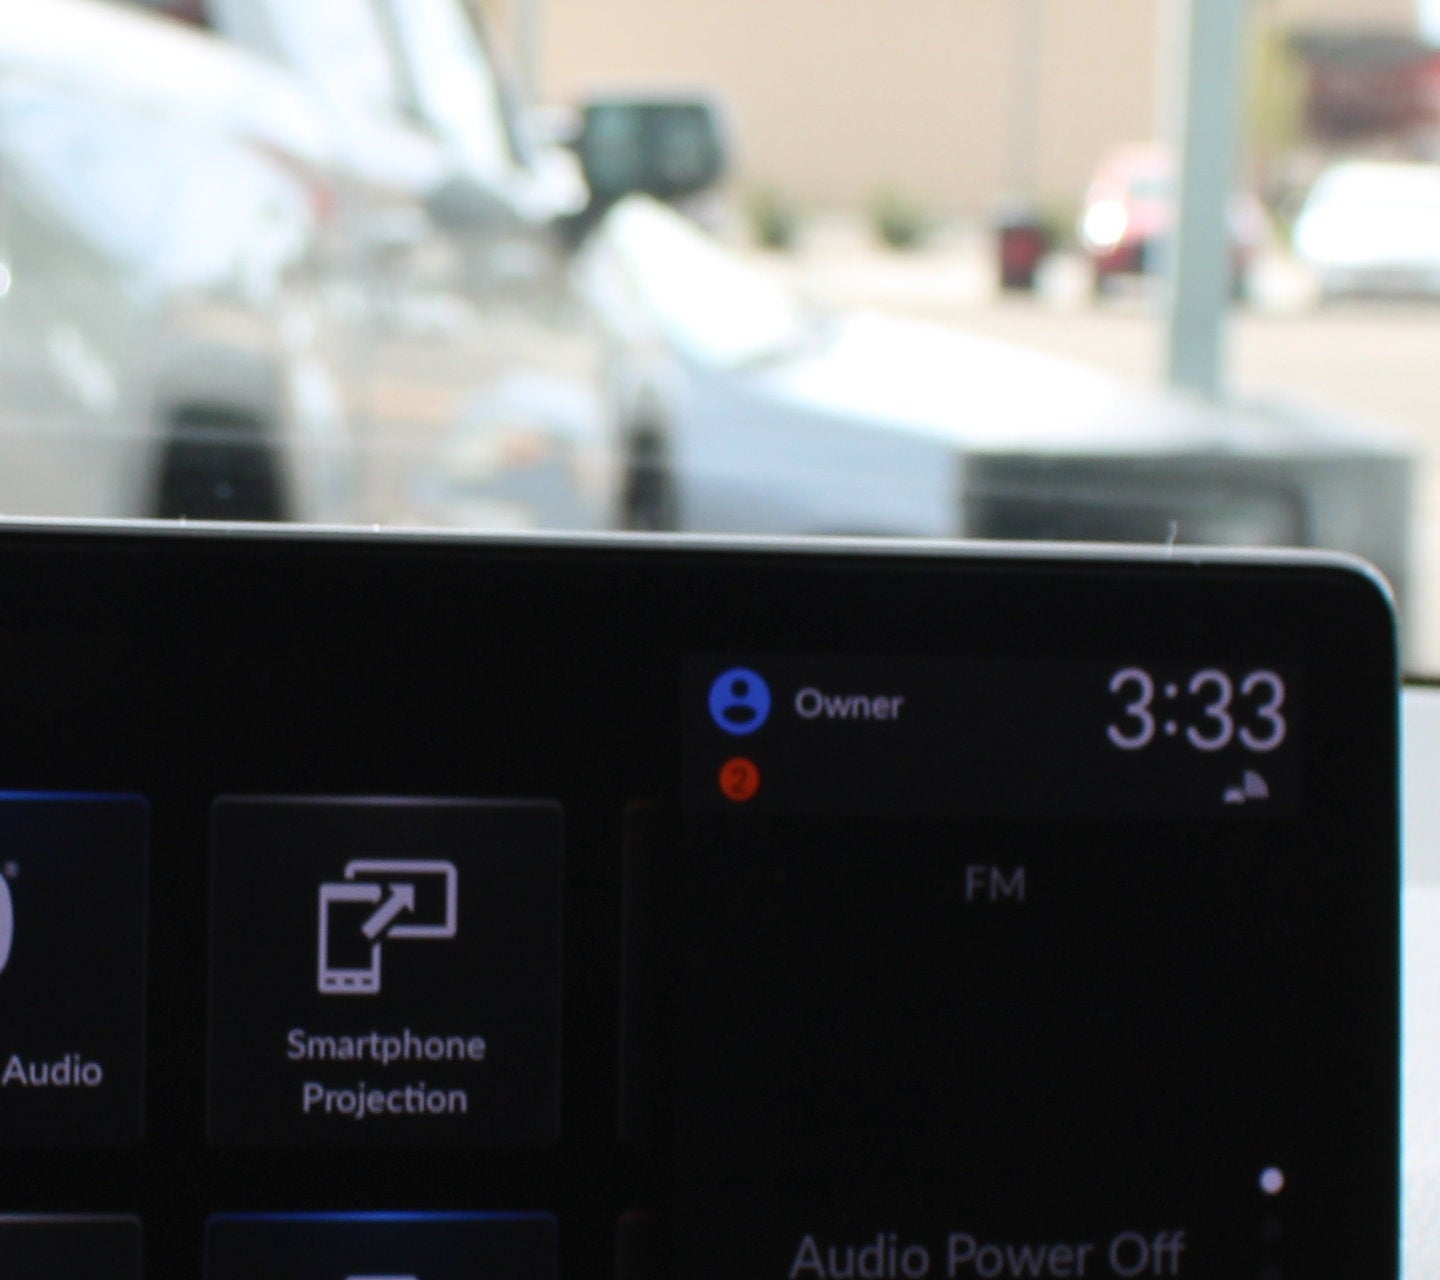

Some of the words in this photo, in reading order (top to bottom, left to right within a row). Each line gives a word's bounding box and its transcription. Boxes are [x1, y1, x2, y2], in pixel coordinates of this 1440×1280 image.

[793, 686, 905, 721] Owner
[1105, 666, 1287, 753] 3:33
[964, 863, 1027, 902] FM
[286, 1027, 487, 1067] Smartphone
[0, 1052, 104, 1087] Audio
[301, 1080, 469, 1120] Projection
[787, 1231, 931, 1280] Audio
[946, 1231, 1095, 1279] Power
[1107, 1228, 1186, 1278] Off
